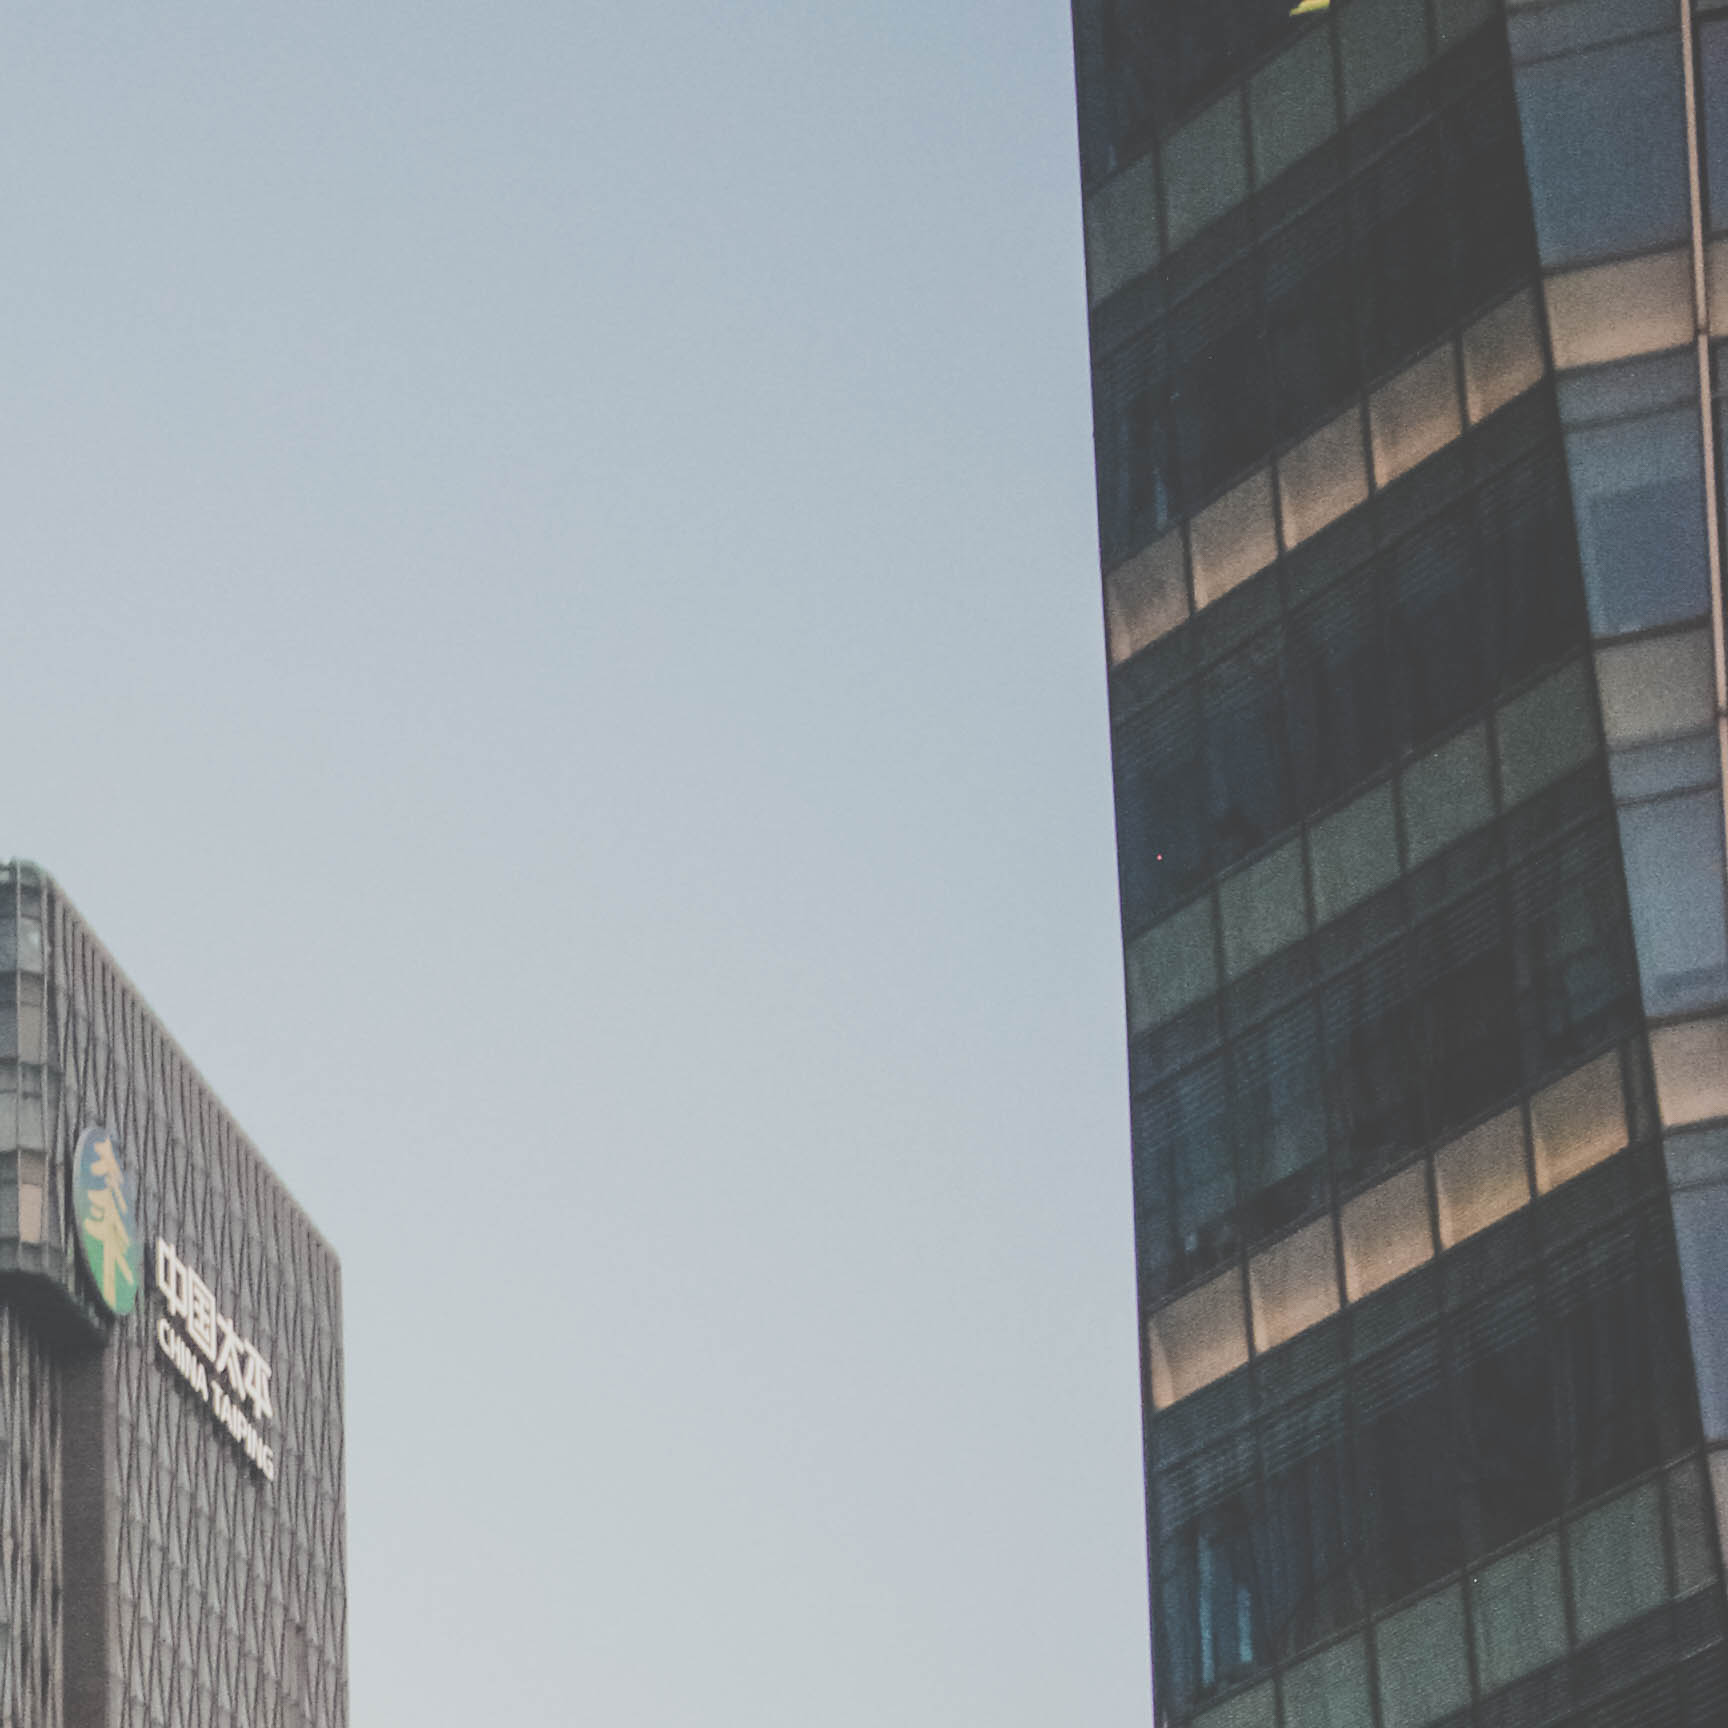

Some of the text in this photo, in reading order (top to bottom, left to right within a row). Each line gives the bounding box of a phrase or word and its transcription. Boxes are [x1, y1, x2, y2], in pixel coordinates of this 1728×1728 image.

[156, 1236, 273, 1420] 中国太平
[156, 1318, 274, 1482] CHINA TAIPING
